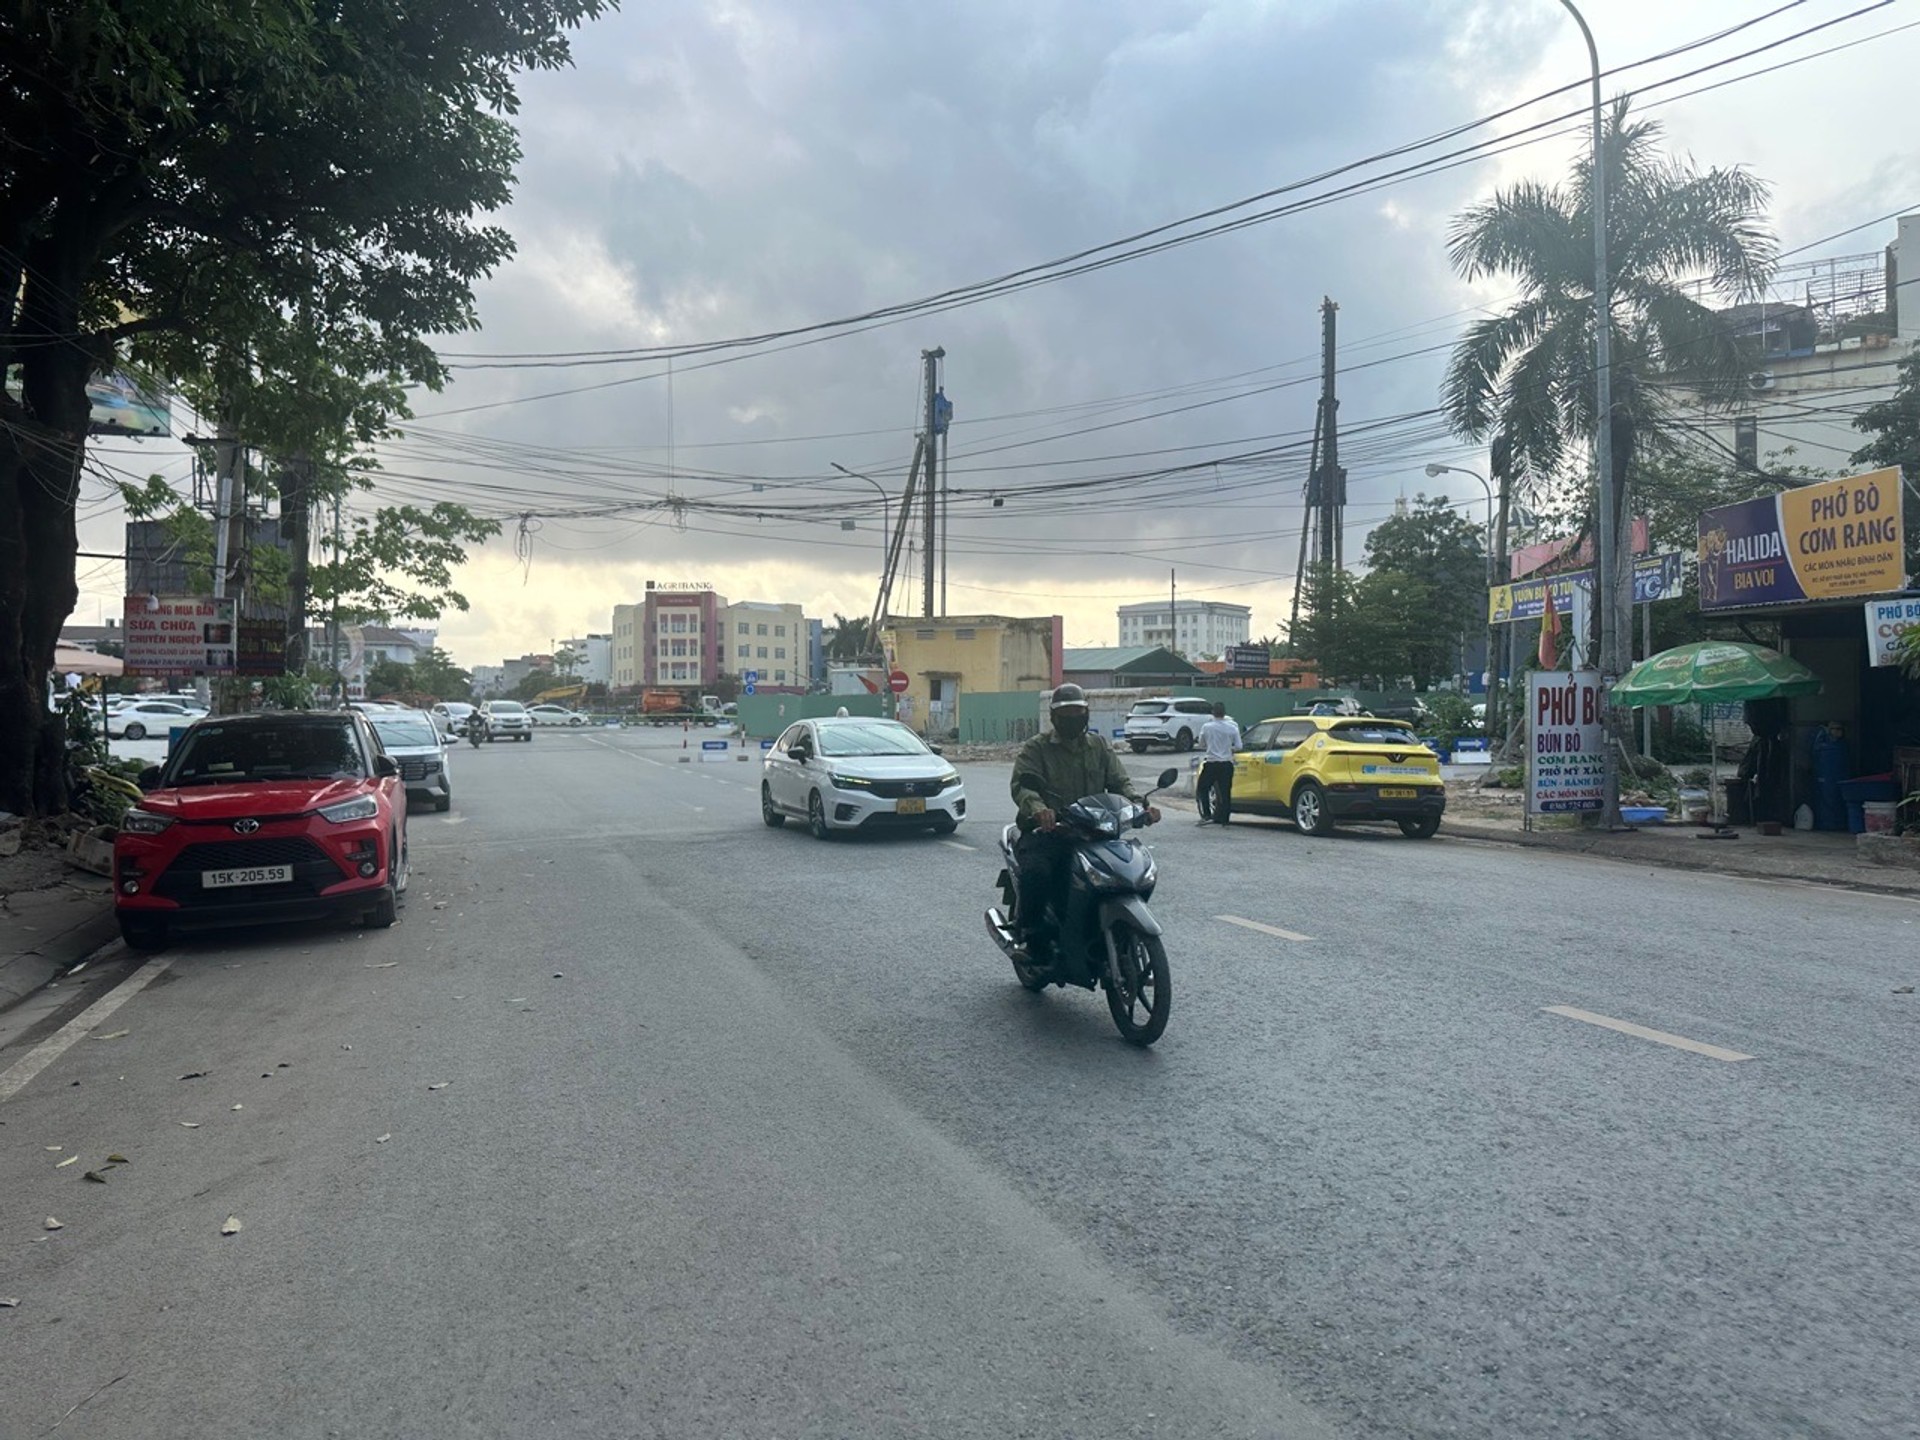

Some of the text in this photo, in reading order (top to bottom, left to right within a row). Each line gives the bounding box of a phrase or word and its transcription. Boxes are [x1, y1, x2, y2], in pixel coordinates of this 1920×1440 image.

[1811, 482, 1879, 522] PHỞ BÒ
[1800, 516, 1896, 555] CƠM RANG
[1725, 531, 1782, 565] HALIDA
[1803, 561, 1817, 573] CÁC
[657, 582, 713, 590] AGRIBANK
[1734, 569, 1775, 589] BIA VOI
[1538, 673, 1577, 726] PHỞ
[1537, 728, 1580, 753] BÚN BÒ
[1538, 755, 1565, 765] CƠM
[1539, 765, 1561, 776] PHỞ
[1536, 789, 1555, 799] CÁC
[211, 868, 285, 884] 15K-205.59
